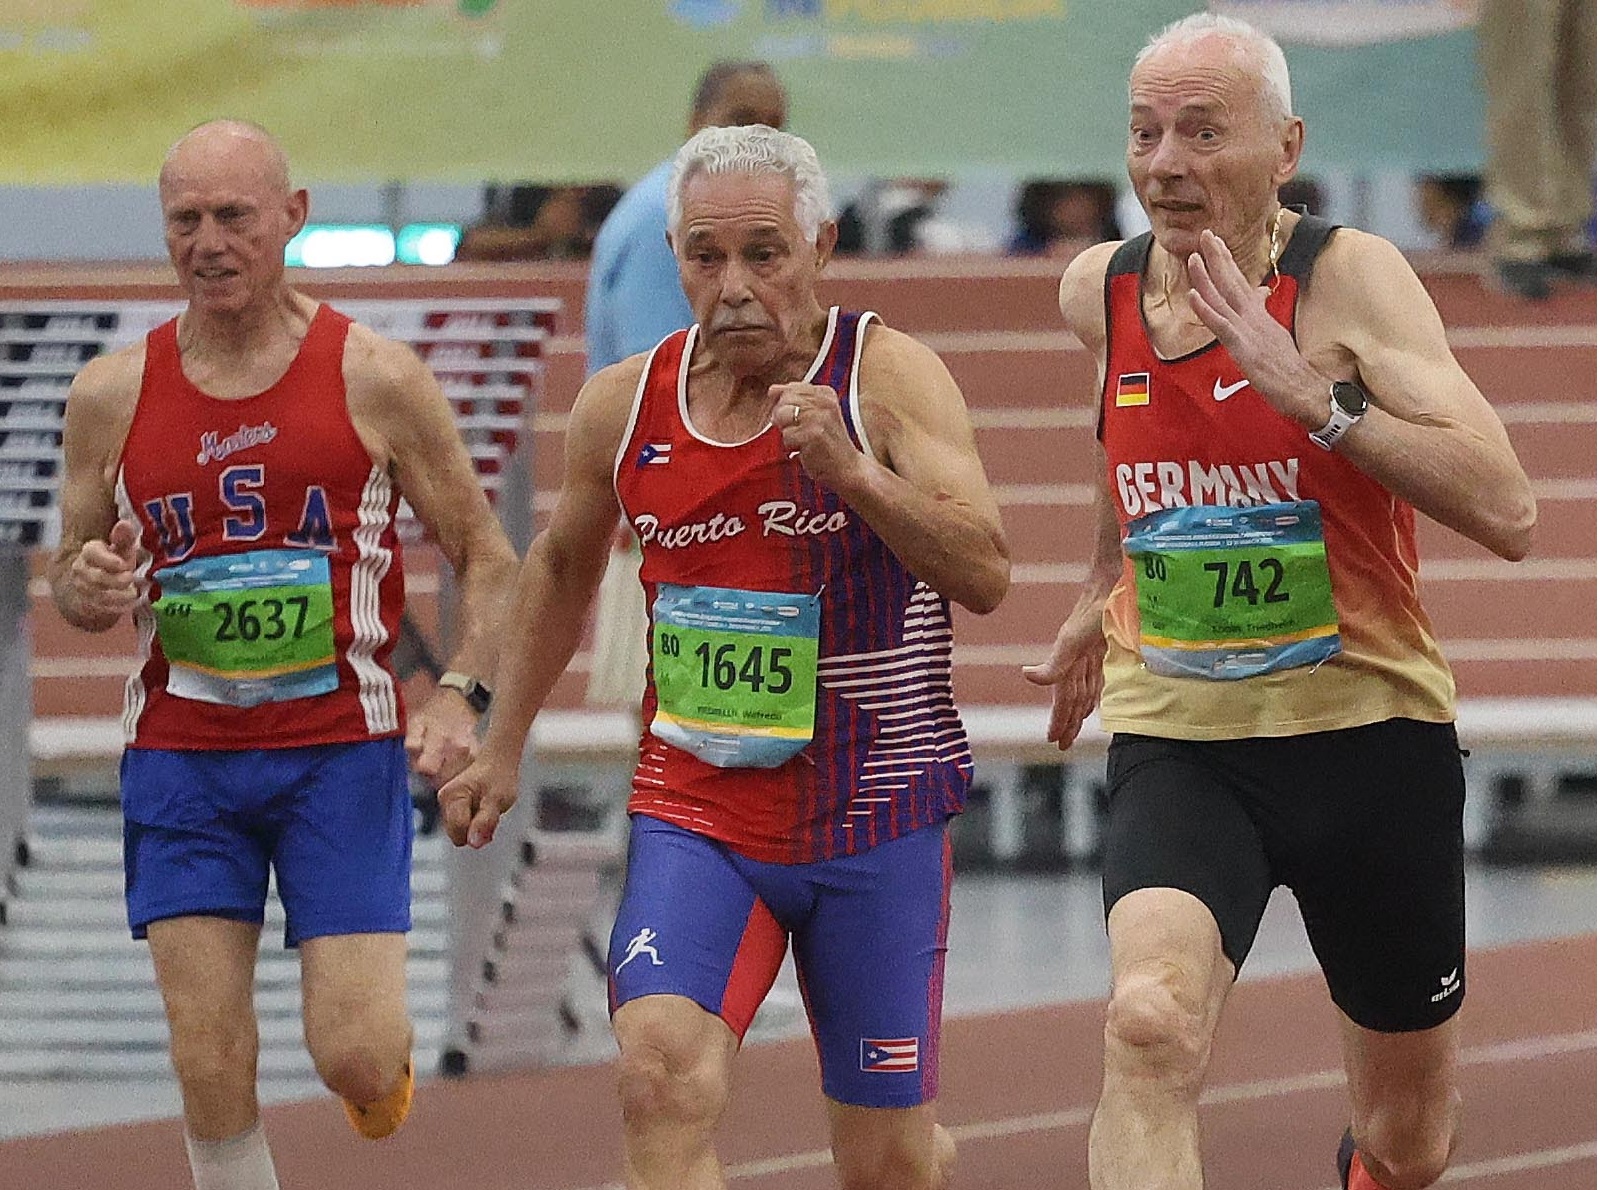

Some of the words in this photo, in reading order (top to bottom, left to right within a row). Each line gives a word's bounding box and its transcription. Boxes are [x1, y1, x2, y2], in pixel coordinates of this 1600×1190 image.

[197, 421, 277, 466] Masters
[1116, 458, 1300, 516] GERMANY
[144, 464, 339, 562] USA
[634, 513, 746, 549] Puerto
[757, 501, 849, 536] Rico
[1203, 558, 1290, 608] 742
[213, 596, 309, 642] 2637
[661, 632, 680, 657] 80
[695, 642, 793, 695] 1645
